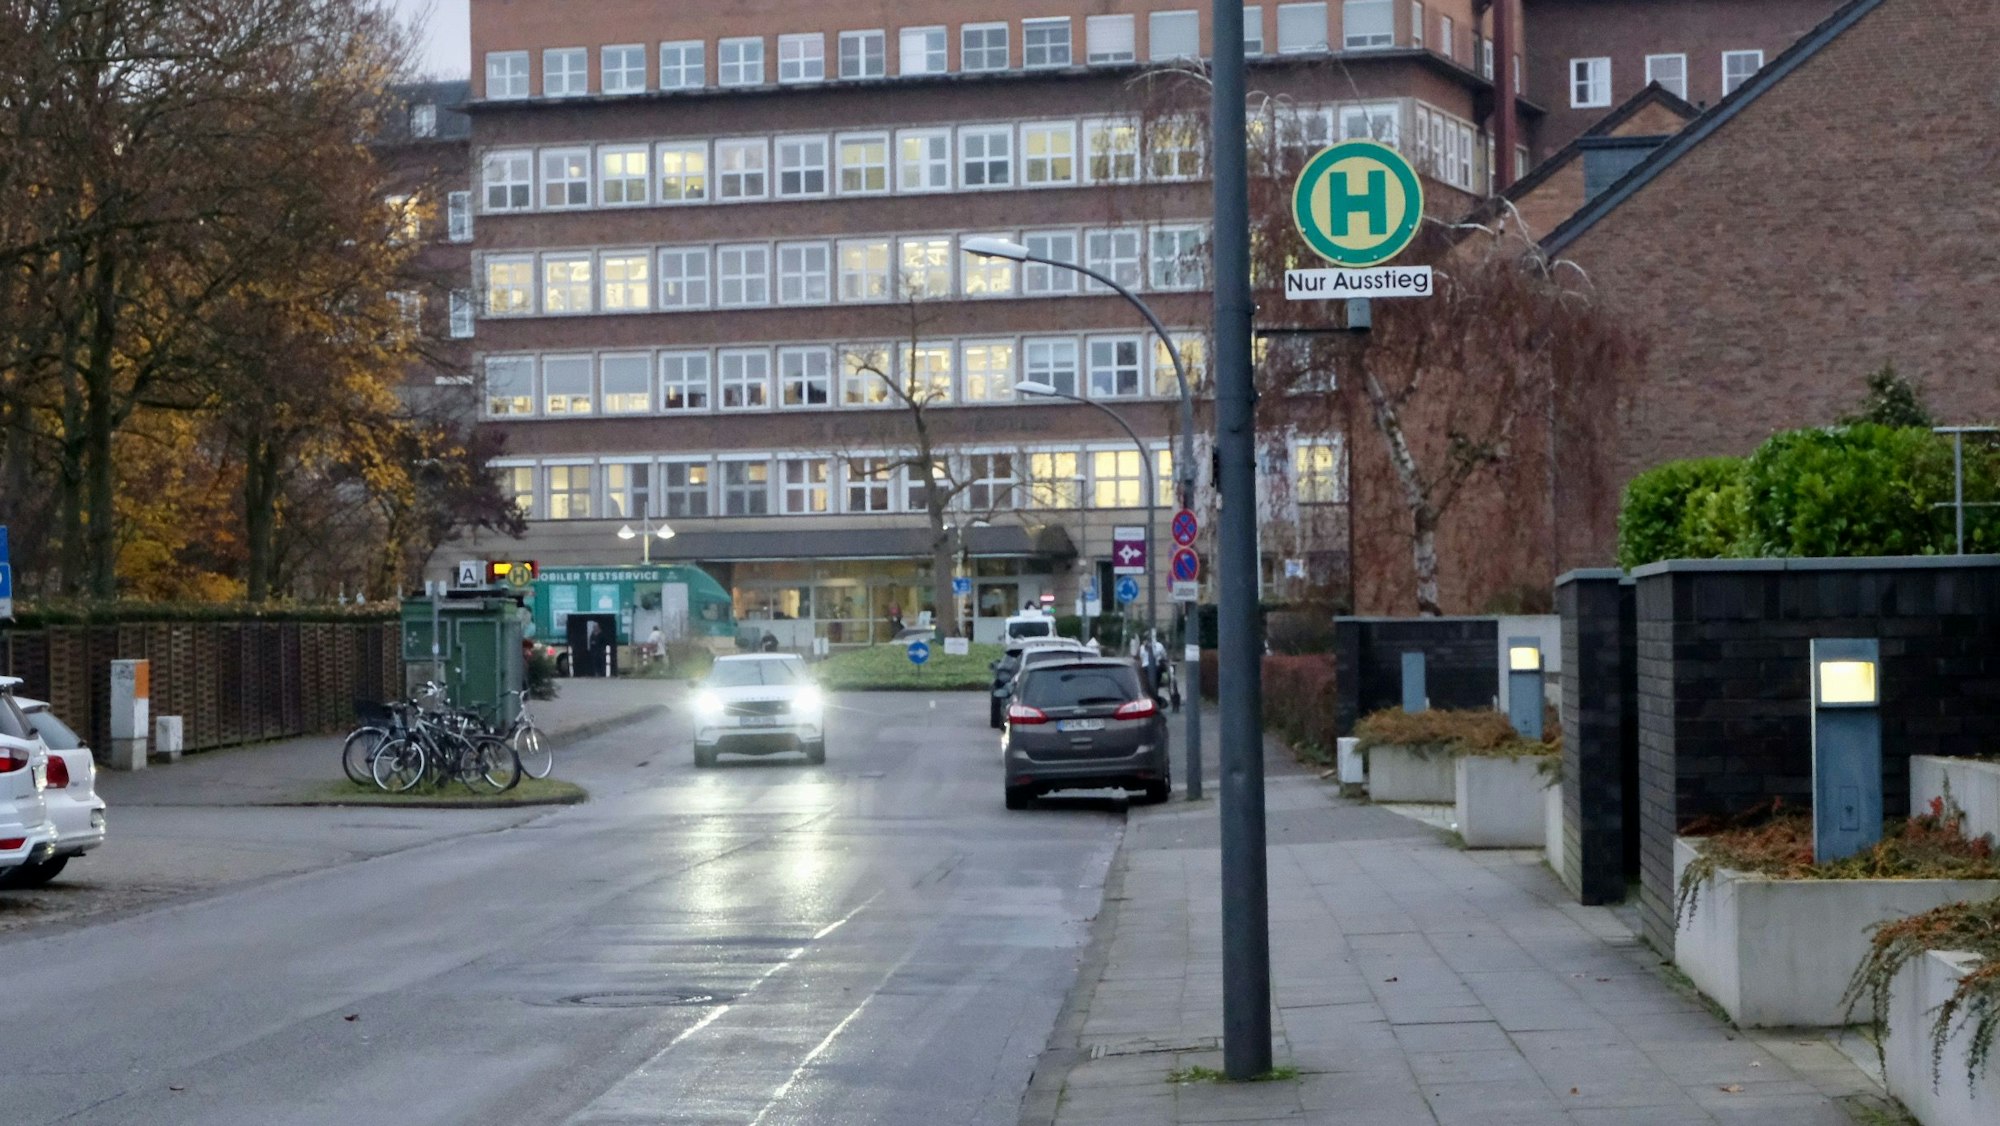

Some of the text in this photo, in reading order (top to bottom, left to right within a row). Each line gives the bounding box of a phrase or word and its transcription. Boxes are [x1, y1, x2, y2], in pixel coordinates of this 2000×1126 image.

[1330, 170, 1387, 236] H
[1287, 270, 1428, 293] Nur Ausstieg
[462, 568, 474, 582] A
[513, 569, 524, 582] H
[584, 571, 659, 582] TESTSERVICE
